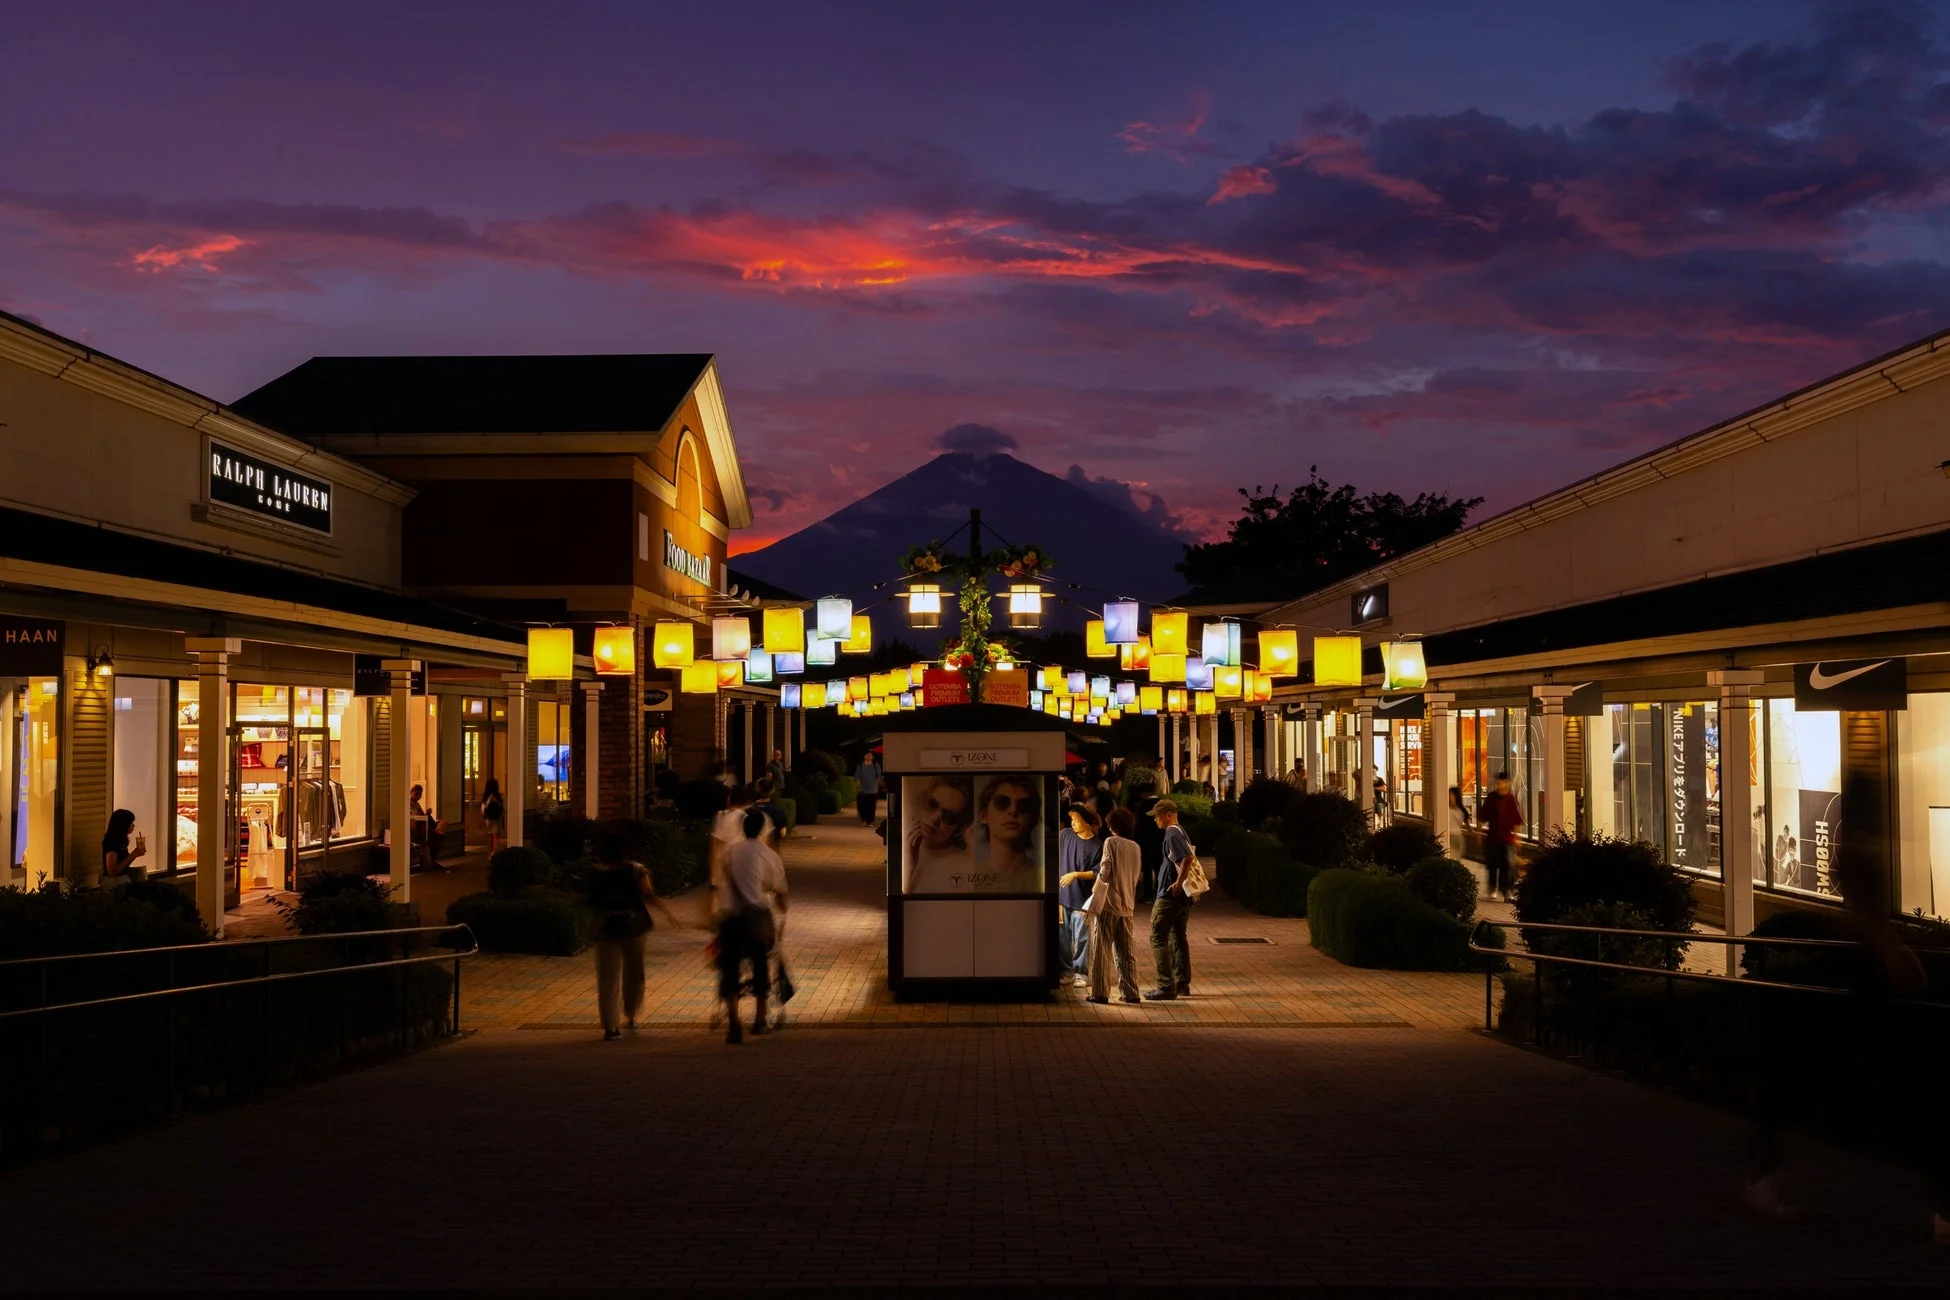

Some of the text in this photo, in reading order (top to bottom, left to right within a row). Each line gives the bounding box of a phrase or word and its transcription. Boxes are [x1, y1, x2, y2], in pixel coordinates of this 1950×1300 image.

[213, 453, 328, 511] RALPH LAUREN
[665, 531, 711, 587] FOOD BAZAAR
[6, 629, 57, 643] HAAN
